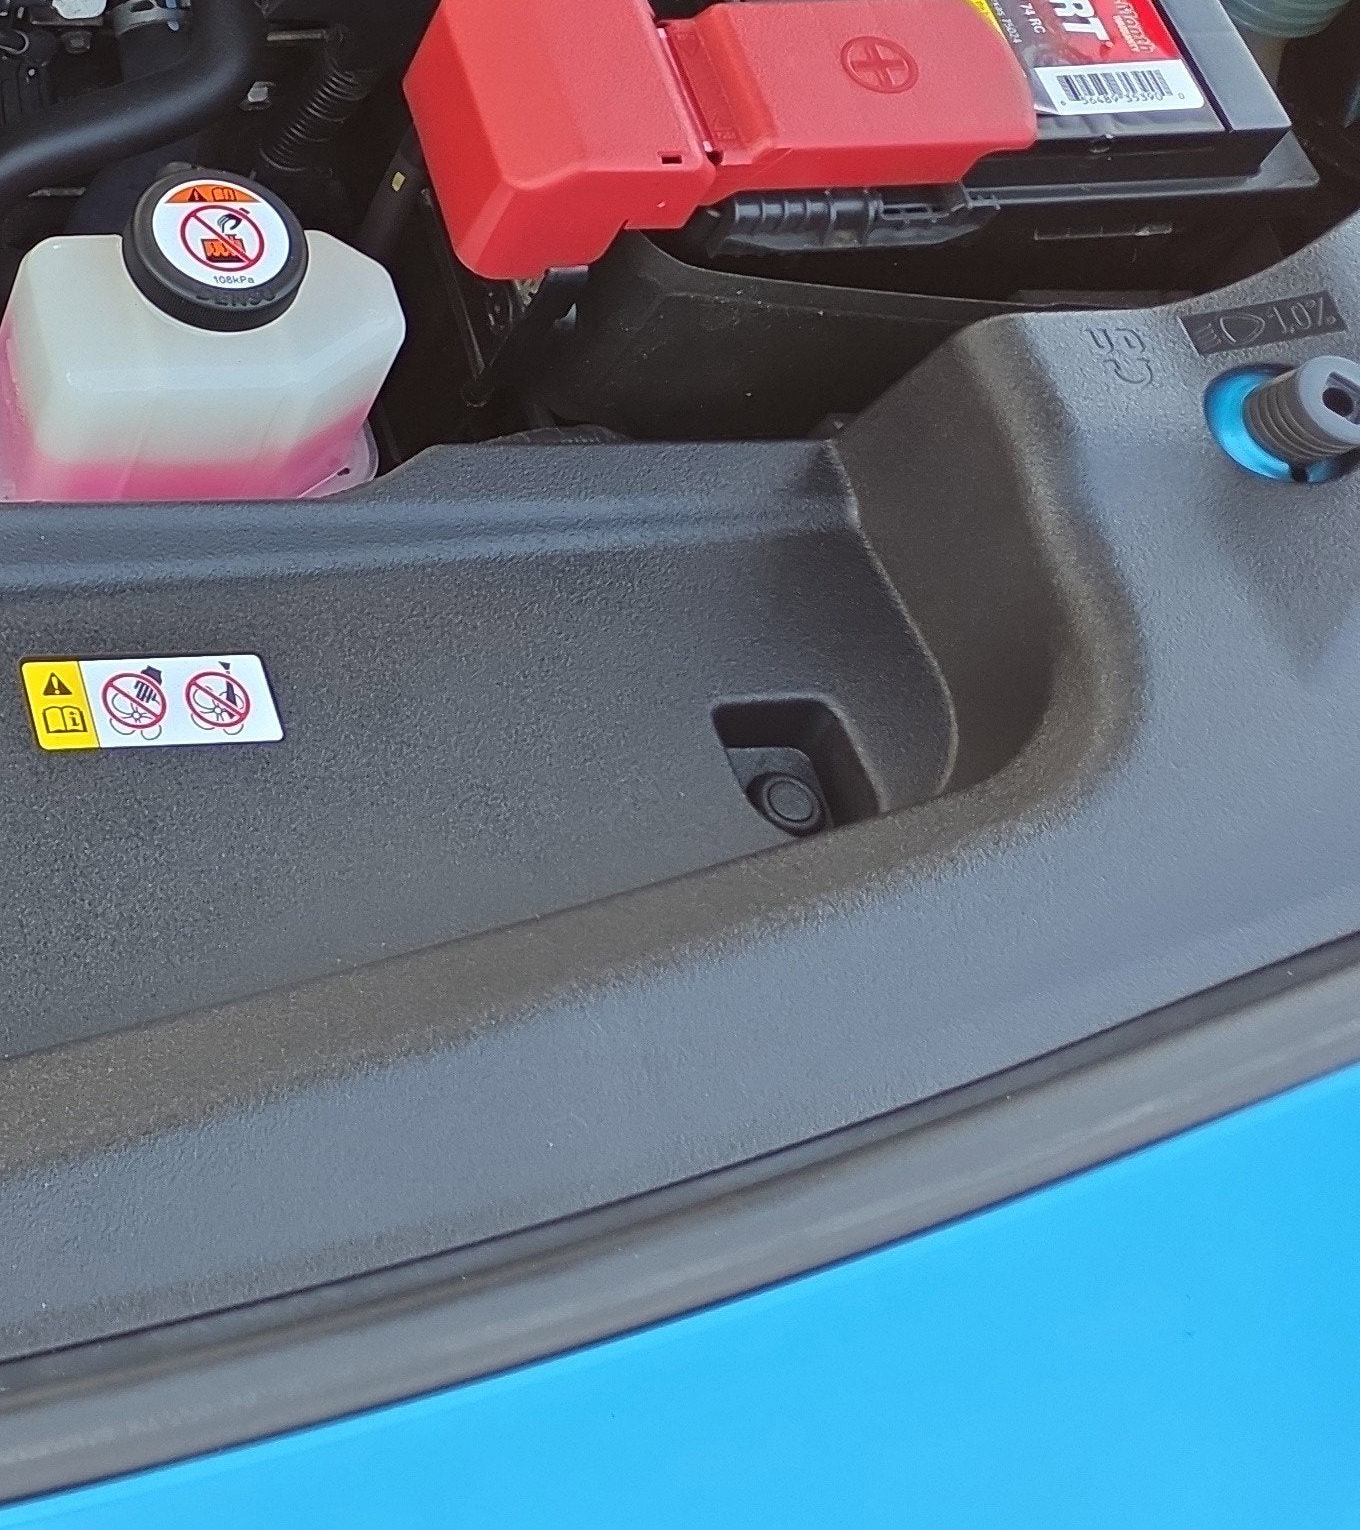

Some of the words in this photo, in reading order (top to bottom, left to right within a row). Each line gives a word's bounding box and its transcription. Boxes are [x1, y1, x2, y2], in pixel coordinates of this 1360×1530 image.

[1019, 3, 1036, 16] 74
[1028, 18, 1047, 34] RC
[213, 274, 255, 284] 108kPa
